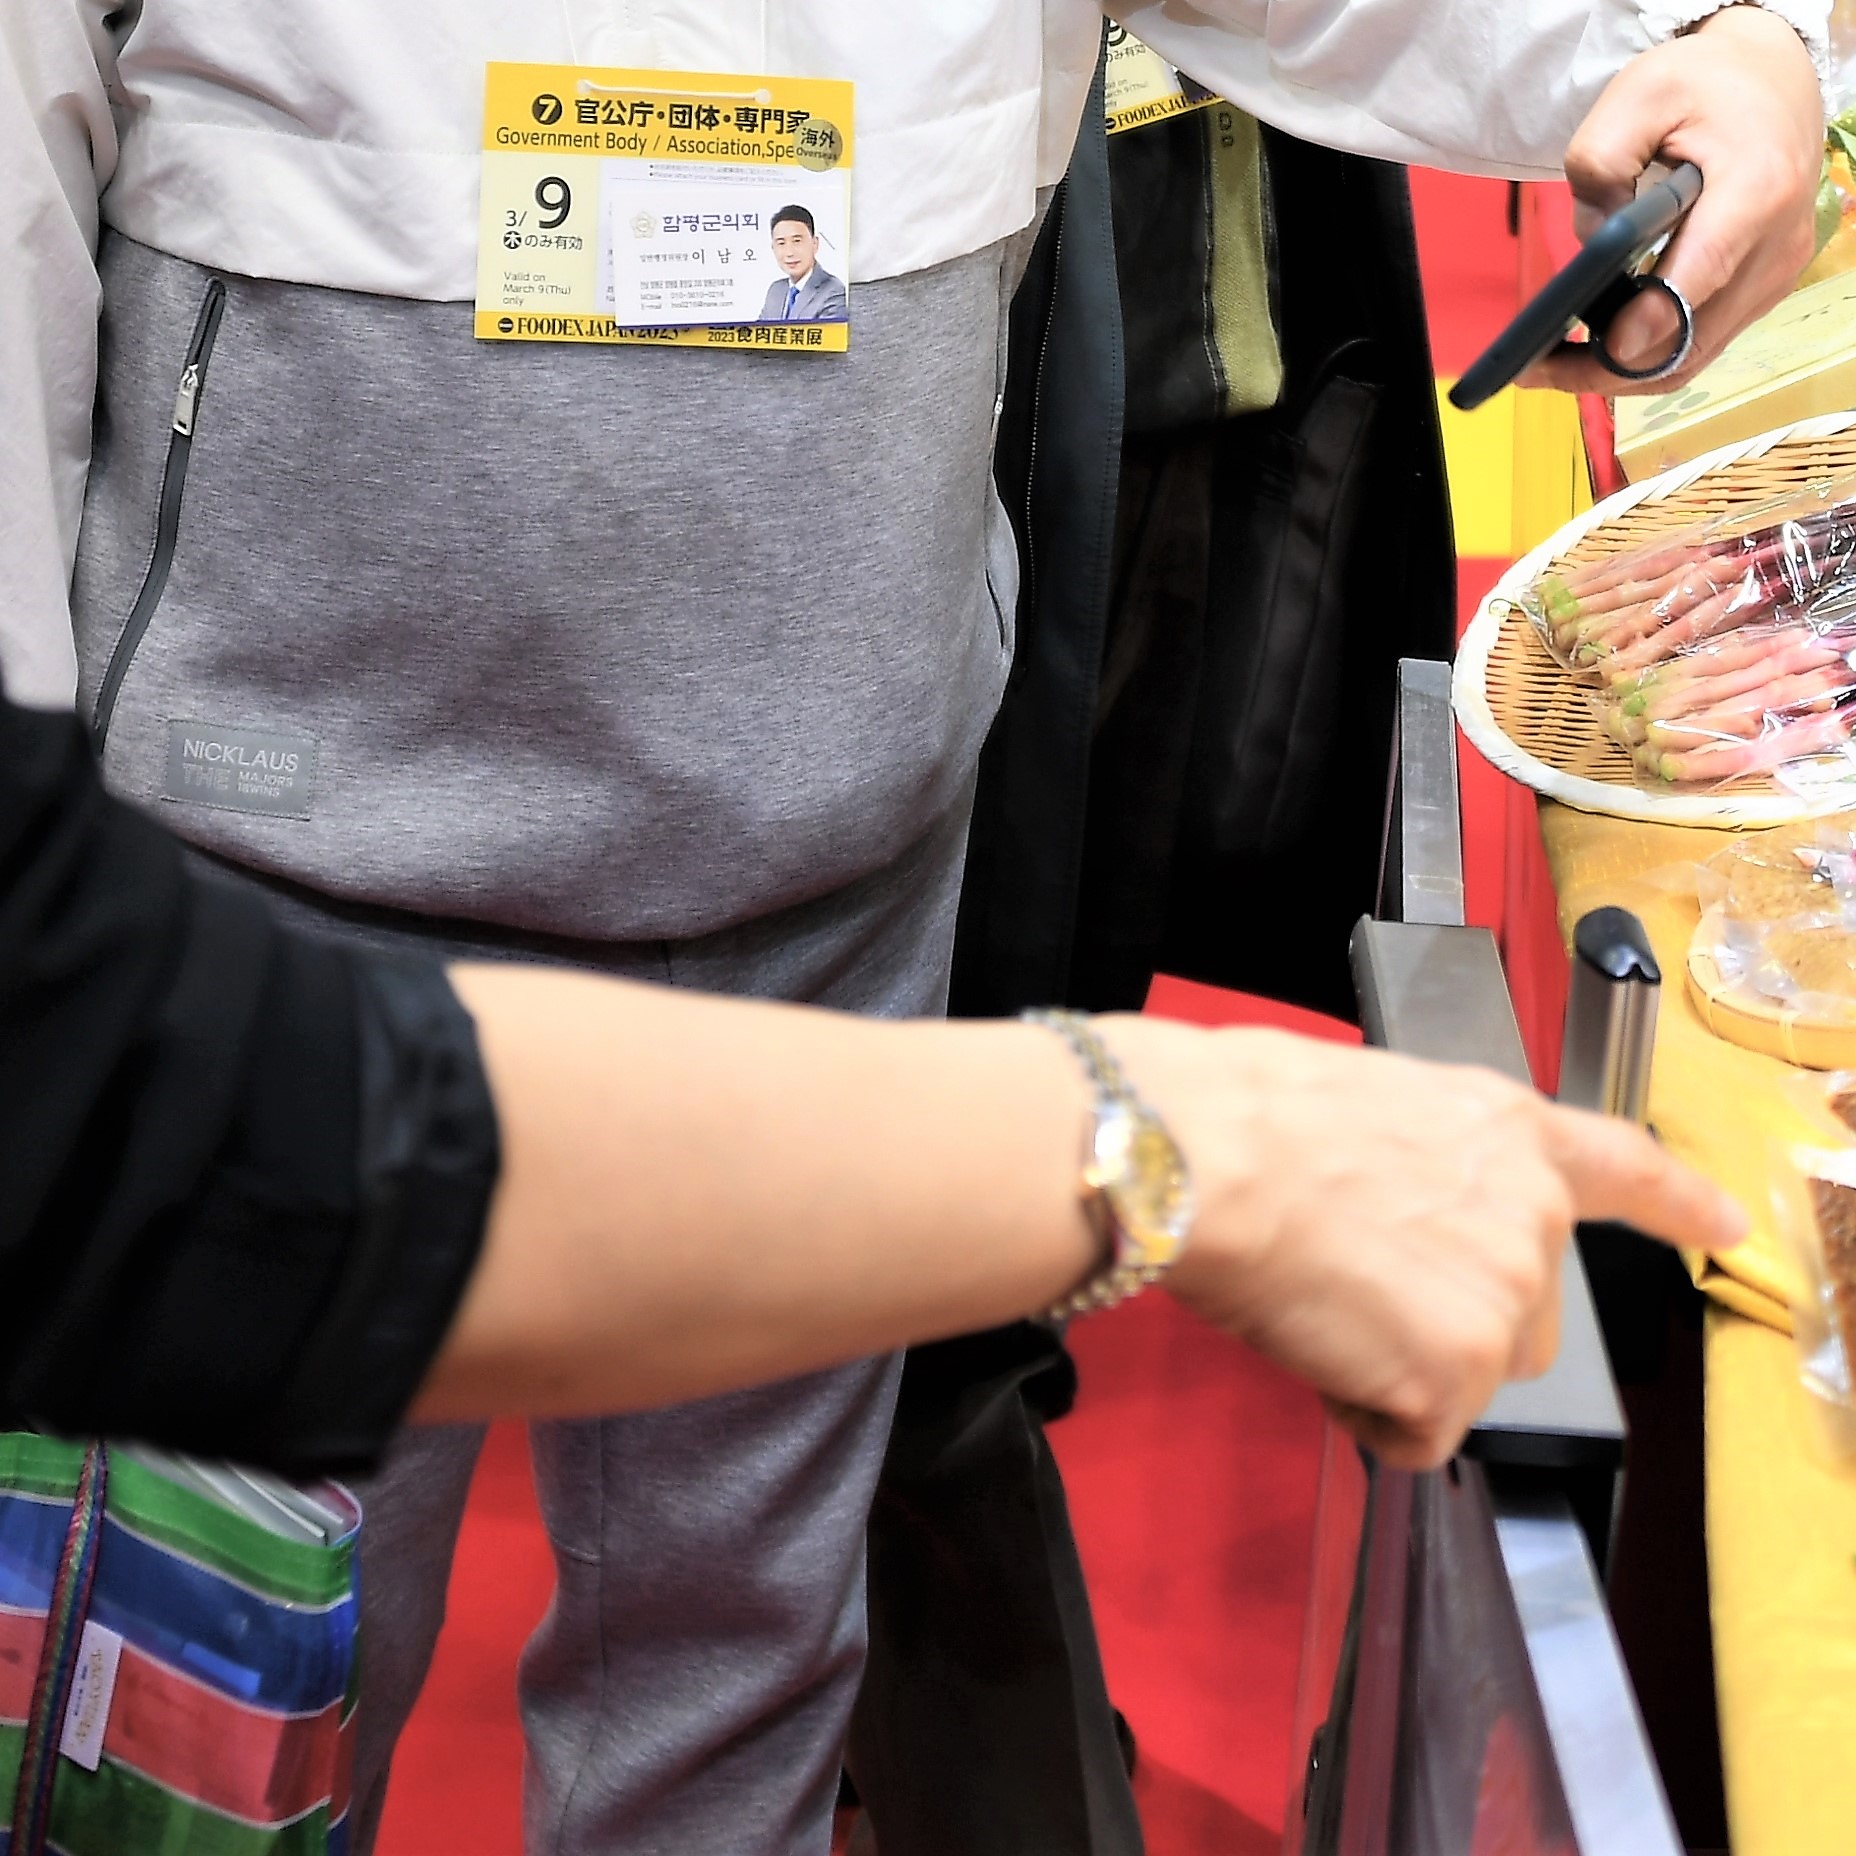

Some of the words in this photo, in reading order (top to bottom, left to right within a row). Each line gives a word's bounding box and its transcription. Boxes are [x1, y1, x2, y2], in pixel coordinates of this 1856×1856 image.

[1117, 100, 1167, 127] FOODEX
[496, 126, 601, 150] Government
[605, 132, 647, 155] Body
[800, 127, 835, 149] 海外
[534, 176, 571, 229] 9
[662, 213, 760, 233] 함평군의회
[504, 272, 530, 282] Valid
[533, 274, 546, 282] on
[503, 283, 535, 294] March
[503, 296, 525, 306] only
[517, 317, 584, 336] FOODEX
[183, 738, 299, 772] NICKLAUS
[183, 762, 231, 791] THE
[238, 771, 294, 788] MAJORS
